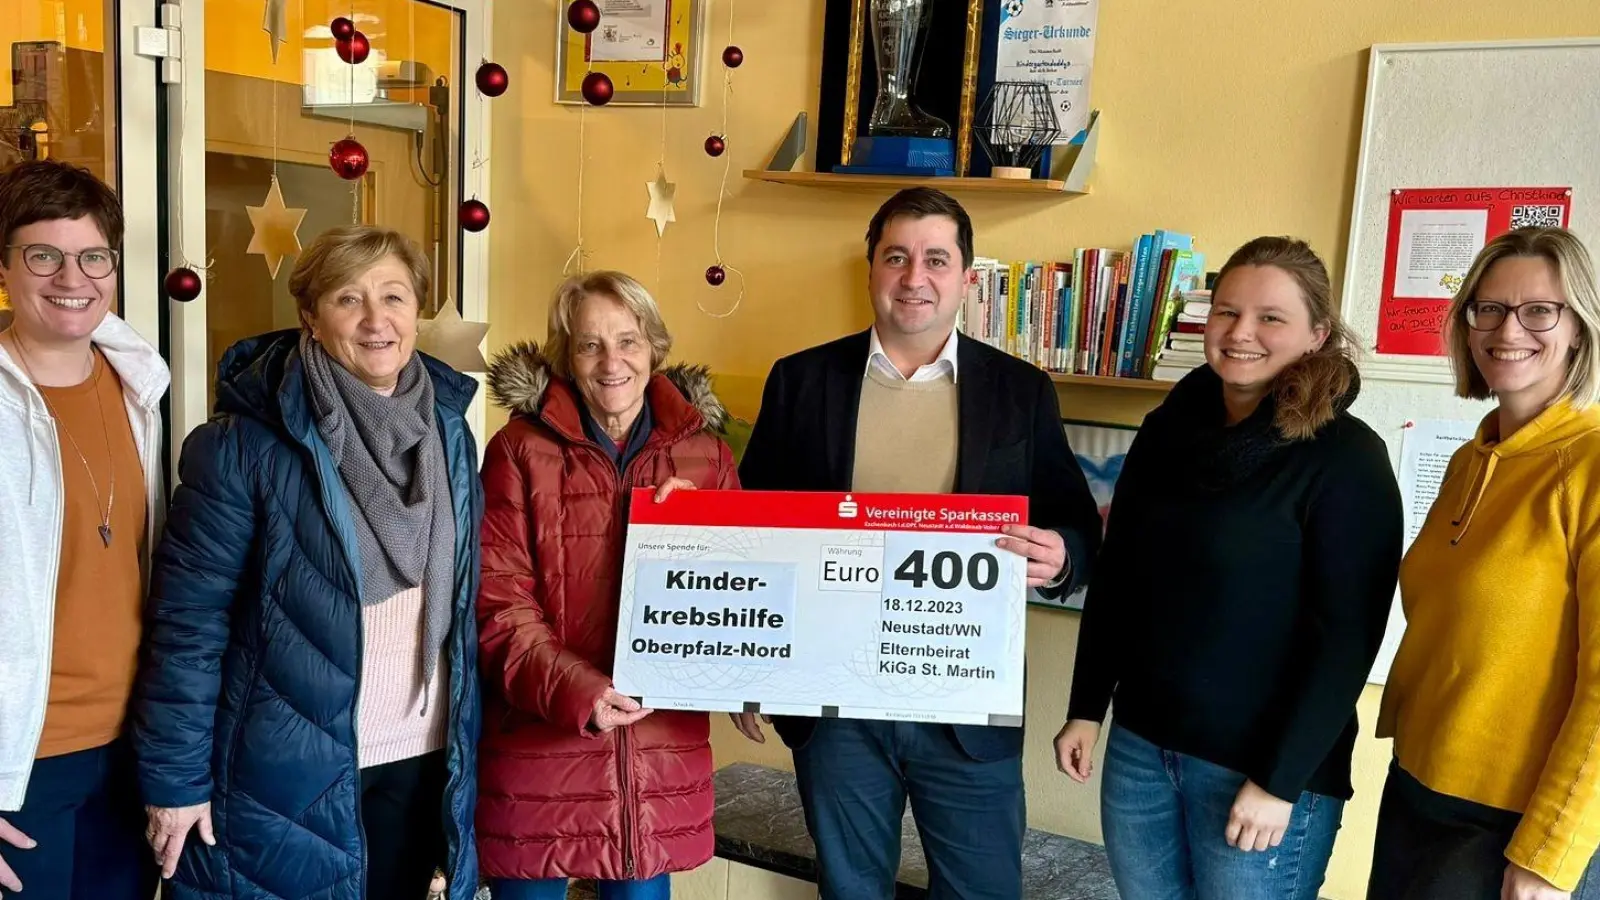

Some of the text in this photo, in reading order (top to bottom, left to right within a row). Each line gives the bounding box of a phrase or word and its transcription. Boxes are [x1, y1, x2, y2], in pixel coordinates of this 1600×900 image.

[1003, 25, 1092, 41] Sieger-Urkunde
[1418, 194, 1459, 204] warten
[1463, 190, 1493, 202] aufs
[865, 506, 1020, 523] Vereinigte Sparkassen
[638, 542, 665, 551] Unsere
[667, 543, 695, 554] Spende
[828, 547, 863, 557] Währung
[824, 560, 880, 584] Euro
[894, 550, 999, 591] 400
[666, 570, 767, 592] Kinder-
[884, 598, 964, 614] 18.12.2023
[643, 605, 784, 629] krebshilfe
[881, 620, 982, 637] Neustadt/WN
[631, 638, 791, 659] Oberpfalz-Nord
[880, 642, 971, 660] Elternbeirat
[879, 660, 996, 679] KiGa St. Martin
